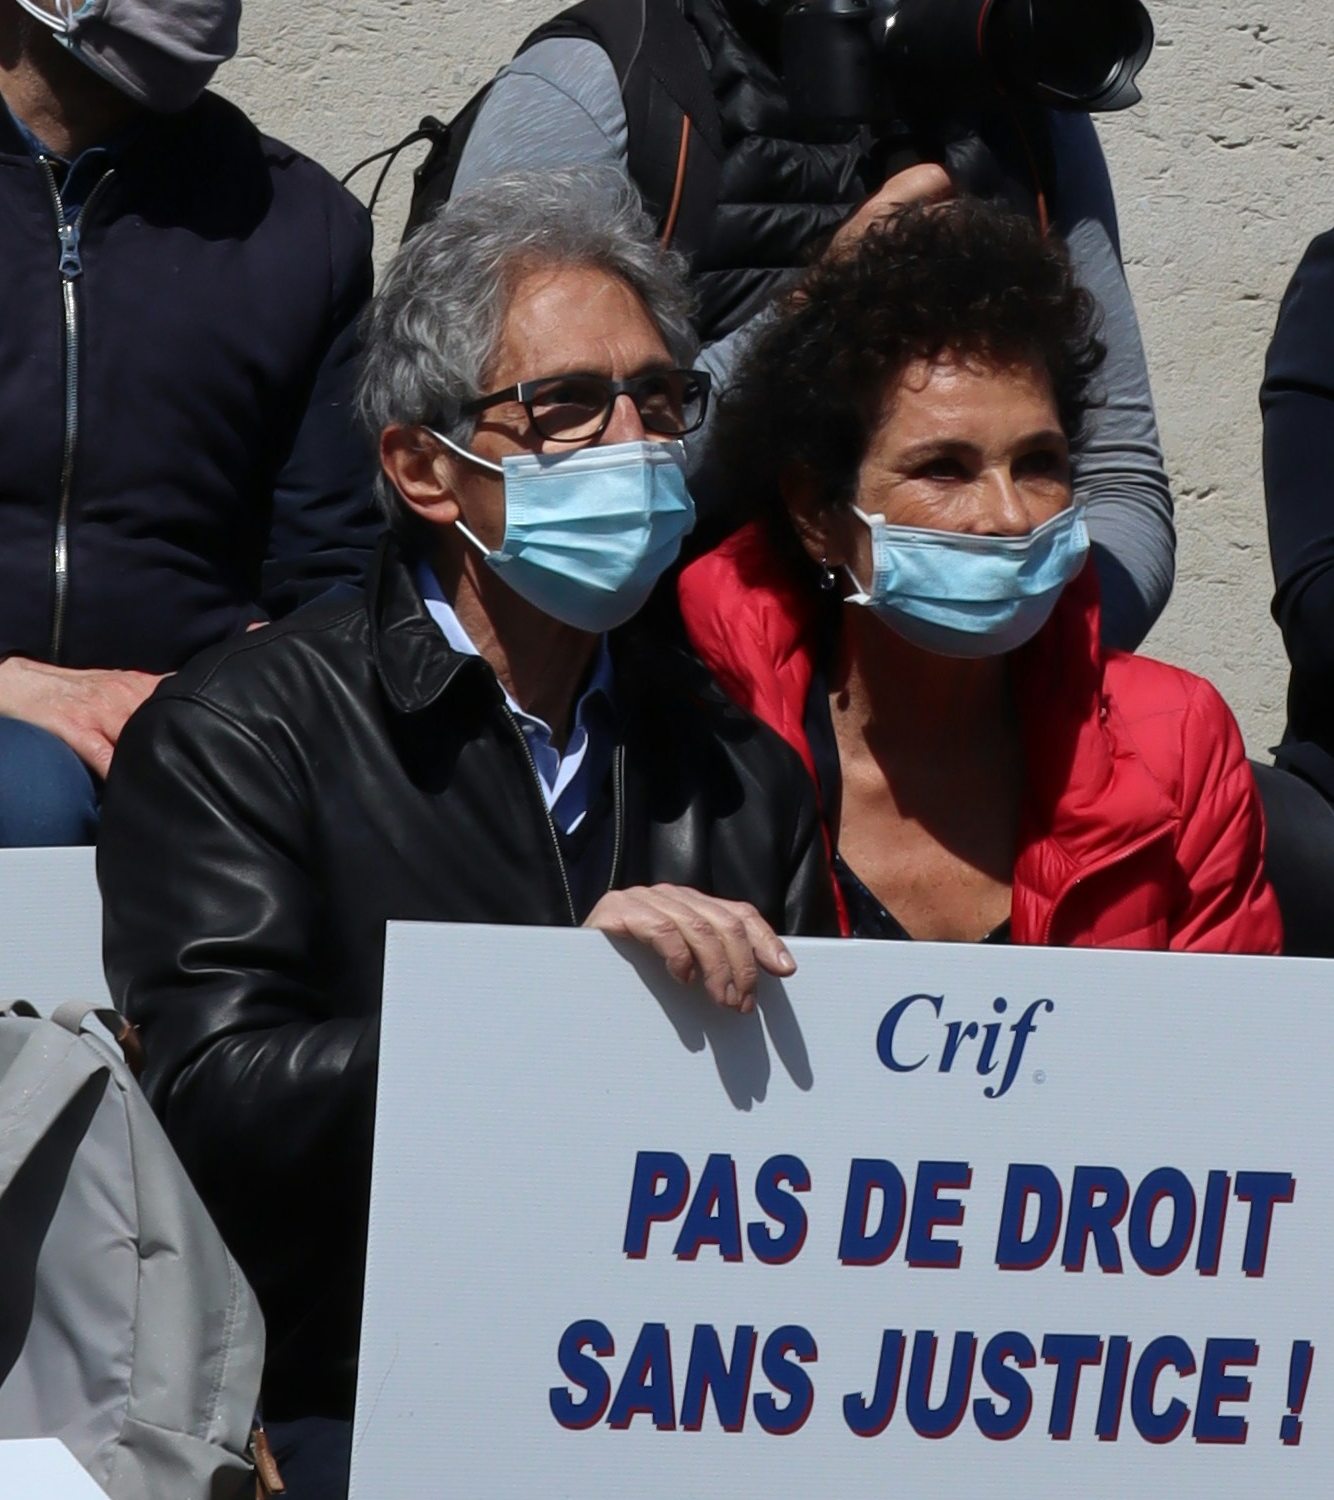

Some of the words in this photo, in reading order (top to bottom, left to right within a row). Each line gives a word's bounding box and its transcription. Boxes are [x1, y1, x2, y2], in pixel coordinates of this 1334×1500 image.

[876, 993, 1054, 1099] Crif
[623, 1150, 811, 1265] PAS
[838, 1158, 973, 1269] DE
[995, 1163, 1296, 1277] DROIT
[549, 1319, 818, 1436] SANS
[842, 1329, 1260, 1445] JUSTICE
[1279, 1340, 1314, 1445] !
